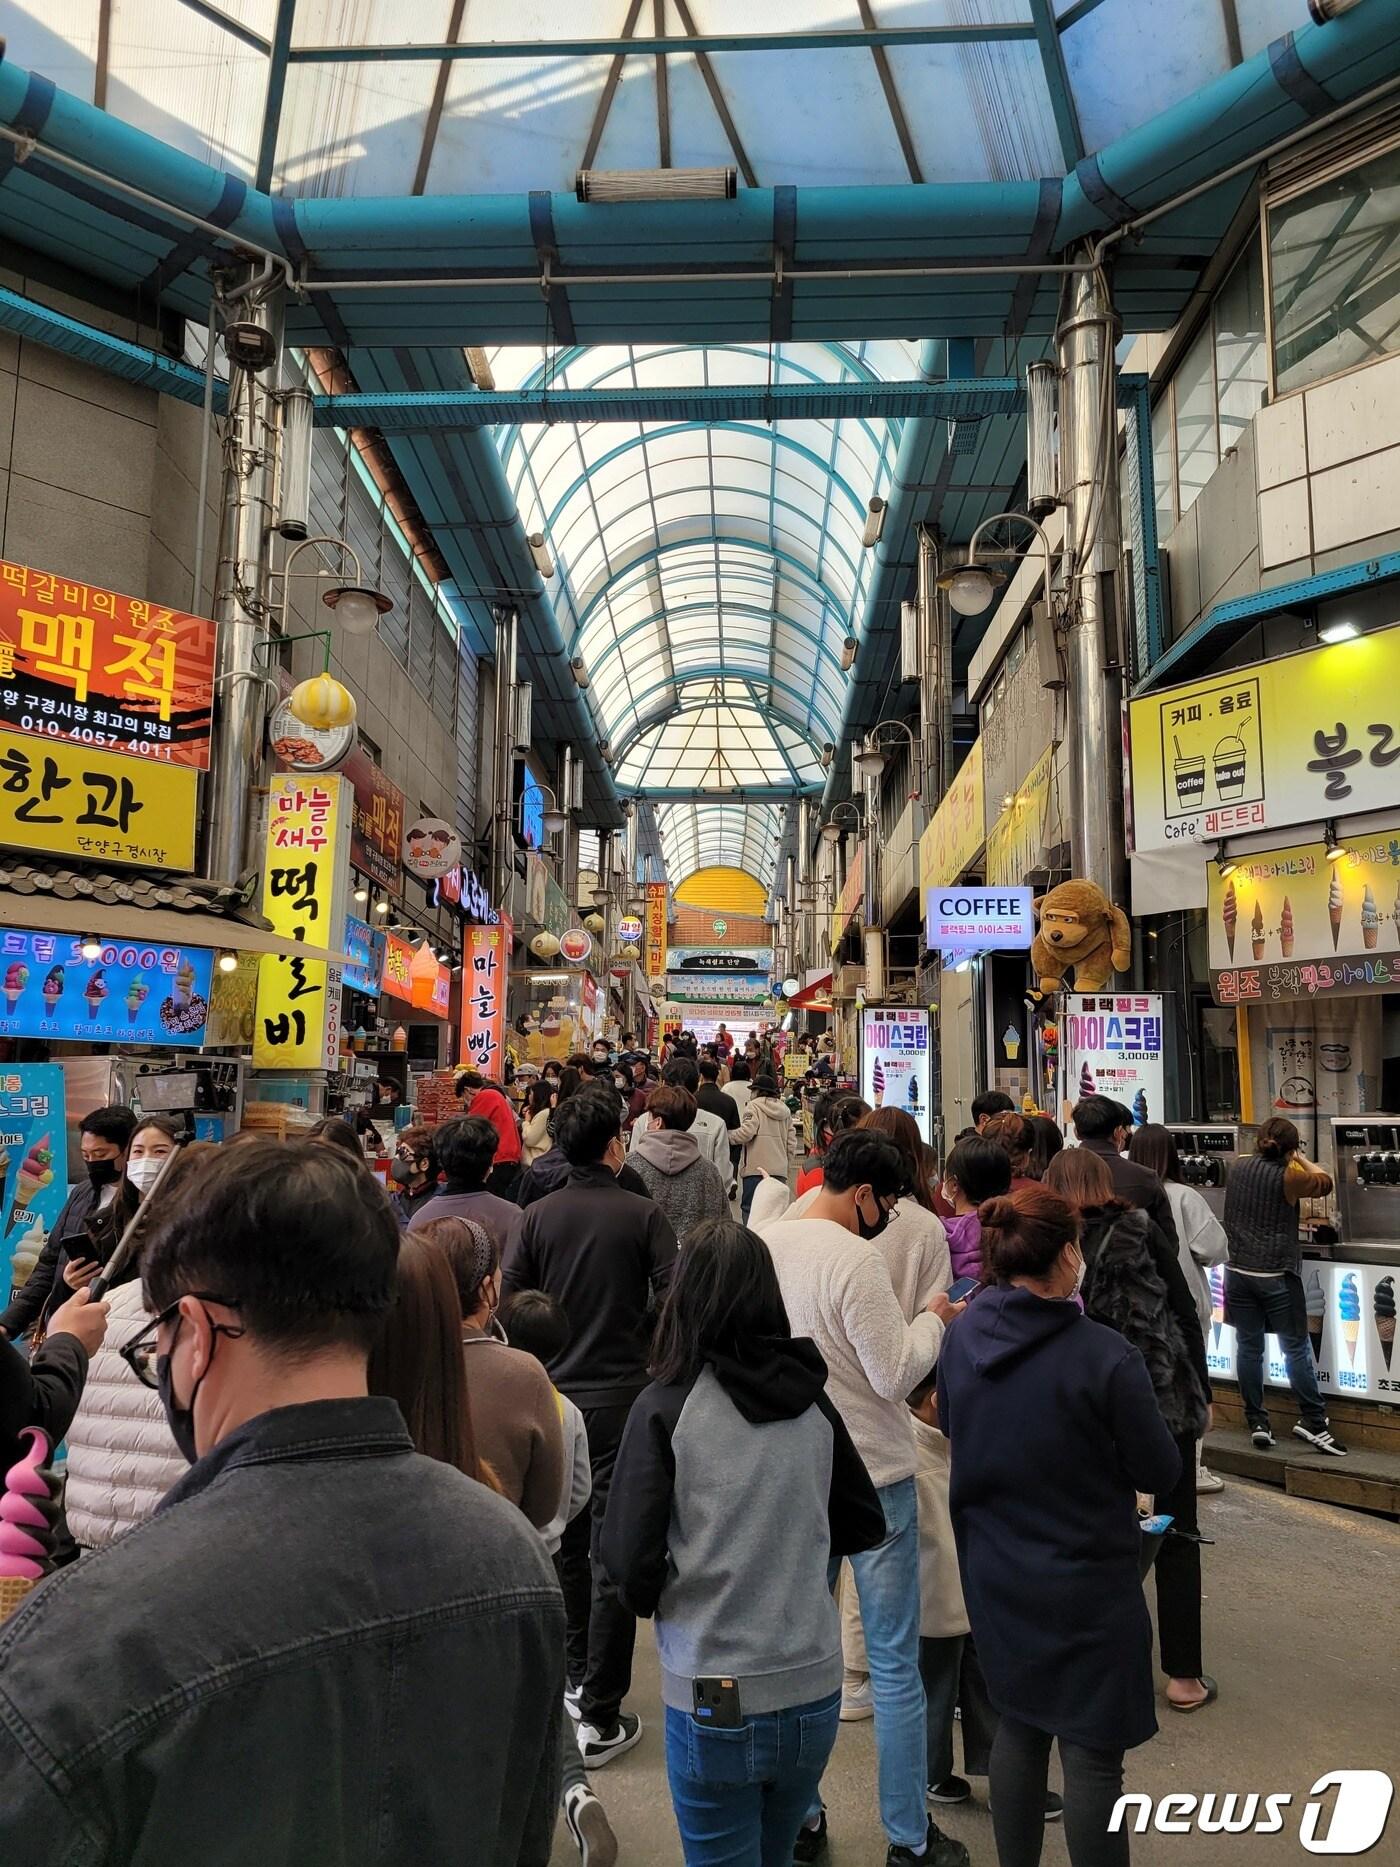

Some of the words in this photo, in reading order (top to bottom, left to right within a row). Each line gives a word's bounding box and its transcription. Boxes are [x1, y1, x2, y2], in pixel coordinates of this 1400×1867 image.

[2, 564, 116, 620] 떡갈비의
[127, 600, 177, 635] 원조
[17, 608, 177, 722] 맥적
[24, 694, 88, 721] 구경시장
[93, 709, 139, 735] 최고의
[143, 721, 172, 741] 맛집
[1171, 703, 1202, 727] 커피
[1218, 690, 1253, 715] 음료
[20, 714, 173, 760] 010.4057.4011
[1177, 776, 1204, 790] coffee
[1215, 770, 1231, 782] take
[1232, 767, 1245, 779] out
[0, 748, 144, 834] 한과
[278, 787, 332, 822] 마늘
[1204, 802, 1265, 834] 레드트리
[76, 835, 168, 864] 단양구경시장
[274, 826, 329, 854] 새우
[939, 898, 1022, 916] COFFEE
[471, 931, 501, 946] 단골
[940, 924, 975, 935] 블랙핑크
[978, 924, 1022, 935] 아이스크림
[328, 968, 342, 983] 음료
[1217, 970, 1262, 1003] 원조
[327, 986, 341, 1001] 커피
[1081, 997, 1150, 1012] 블랙핑크
[467, 950, 498, 1064] 마늘빵
[874, 1011, 920, 1022] 블랙핑크
[866, 1024, 928, 1049] 아이스크림
[1069, 1015, 1161, 1051] 아이스크림
[1118, 1052, 1159, 1061] 3,000원
[1095, 1068, 1137, 1077] 블랙핑크
[13, 1209, 35, 1224] 딸기
